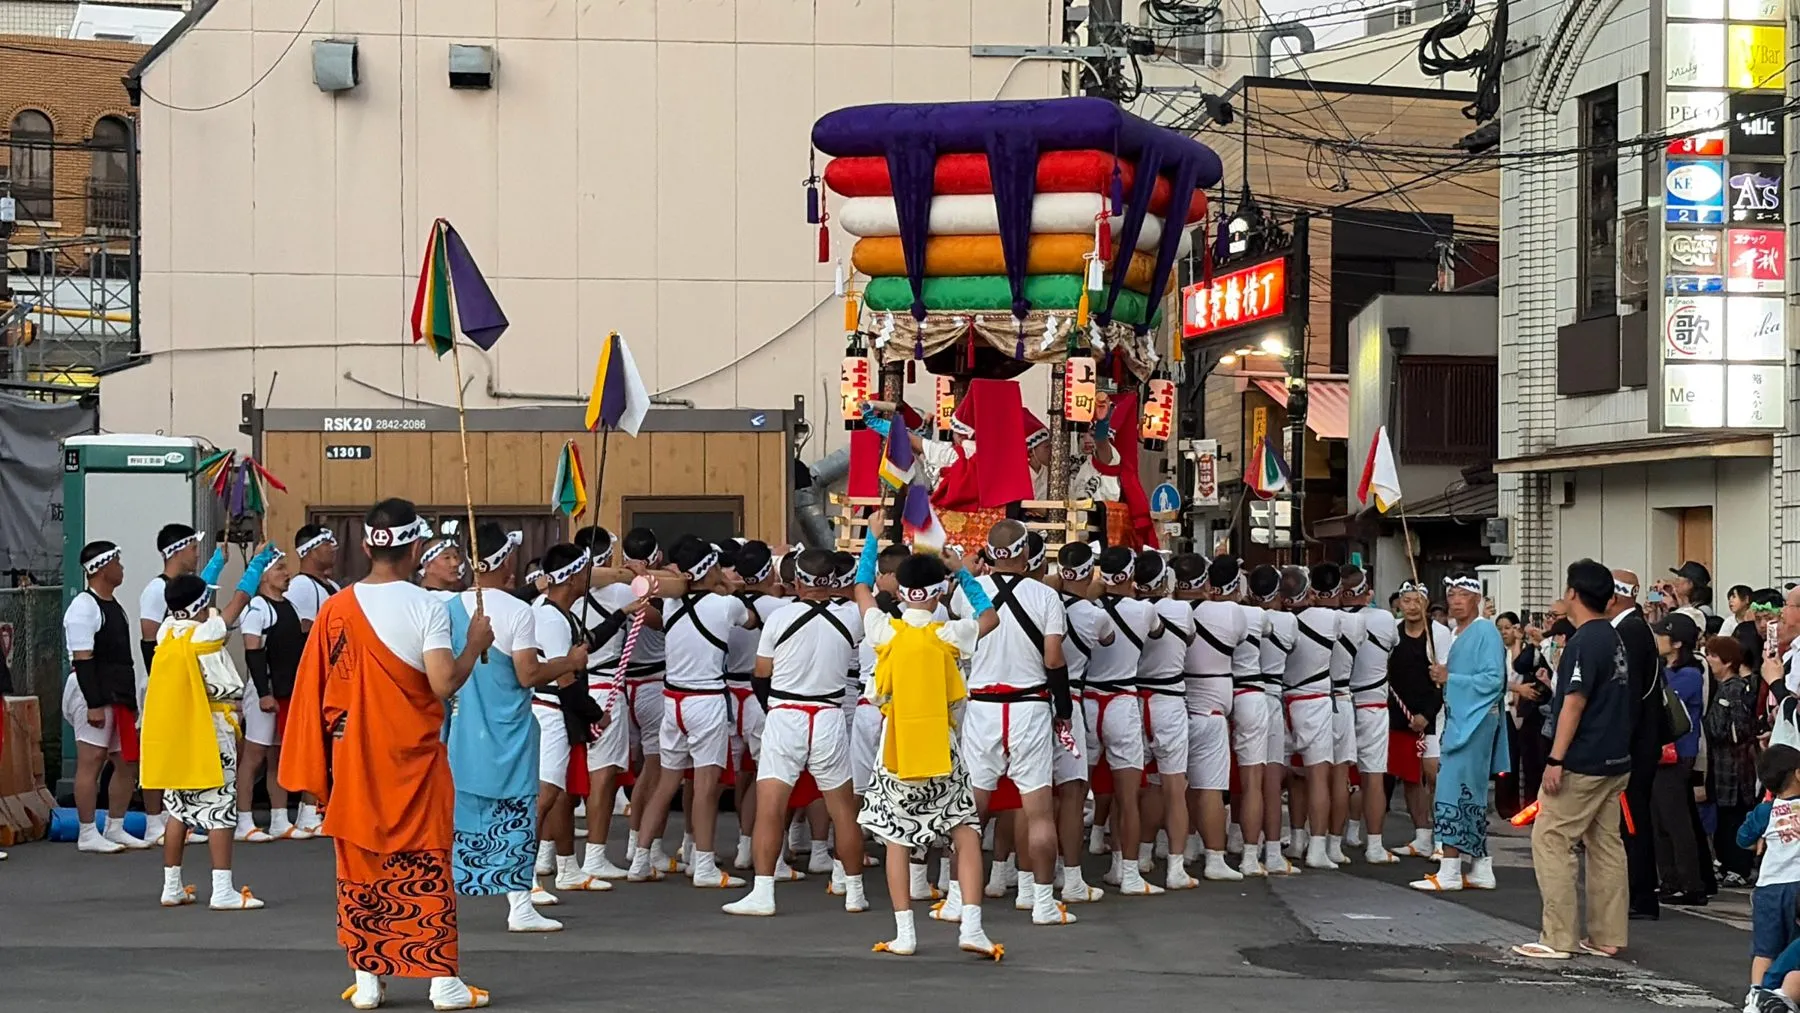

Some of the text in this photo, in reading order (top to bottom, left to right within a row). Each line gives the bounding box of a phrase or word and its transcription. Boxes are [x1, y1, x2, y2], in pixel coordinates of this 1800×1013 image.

[1756, 212, 1780, 220] エース
[1675, 315, 1710, 345] 歌
[1075, 365, 1095, 414] 上町
[324, 417, 426, 431] RSK20 2842-2086
[332, 446, 362, 458] 1301
